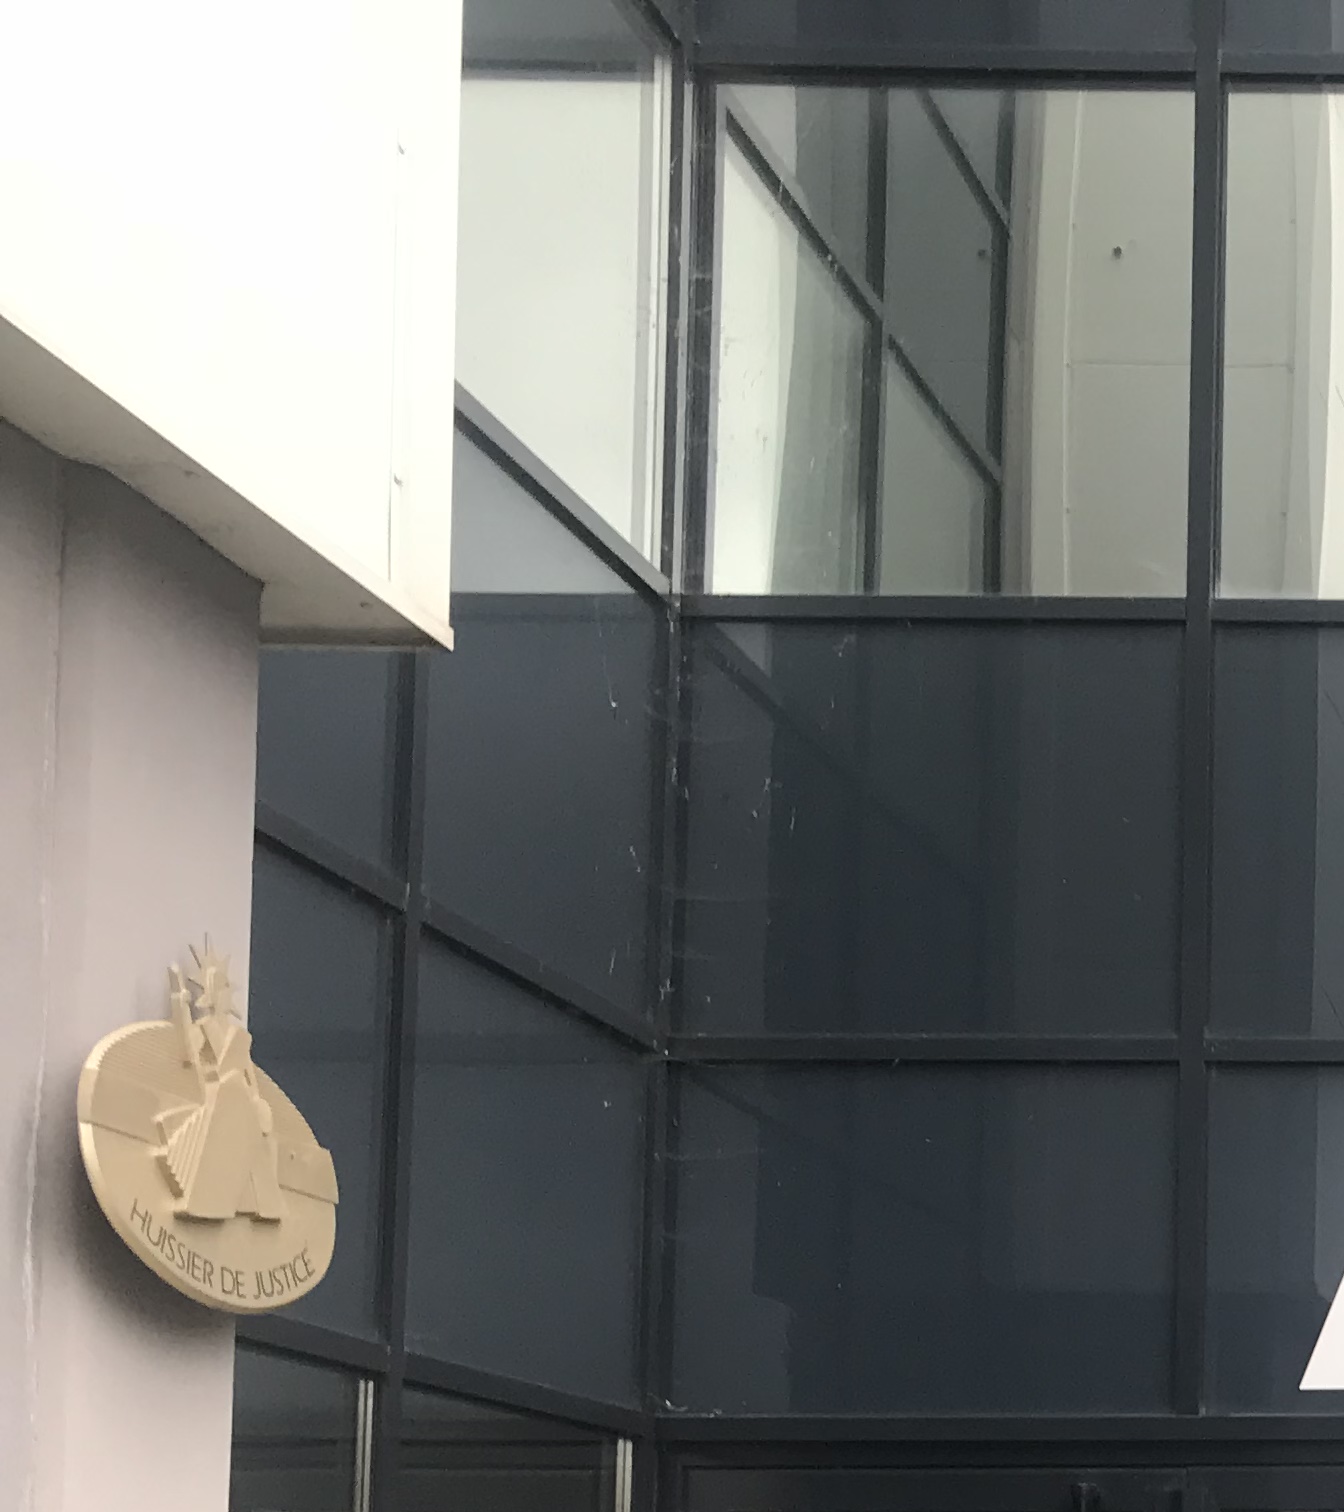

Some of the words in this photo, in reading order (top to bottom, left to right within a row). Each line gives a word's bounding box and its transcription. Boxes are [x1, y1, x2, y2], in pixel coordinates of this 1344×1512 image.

[129, 1198, 214, 1287] HUISSIER
[220, 1266, 247, 1298] DE
[252, 1246, 316, 1299] JUSTICE
